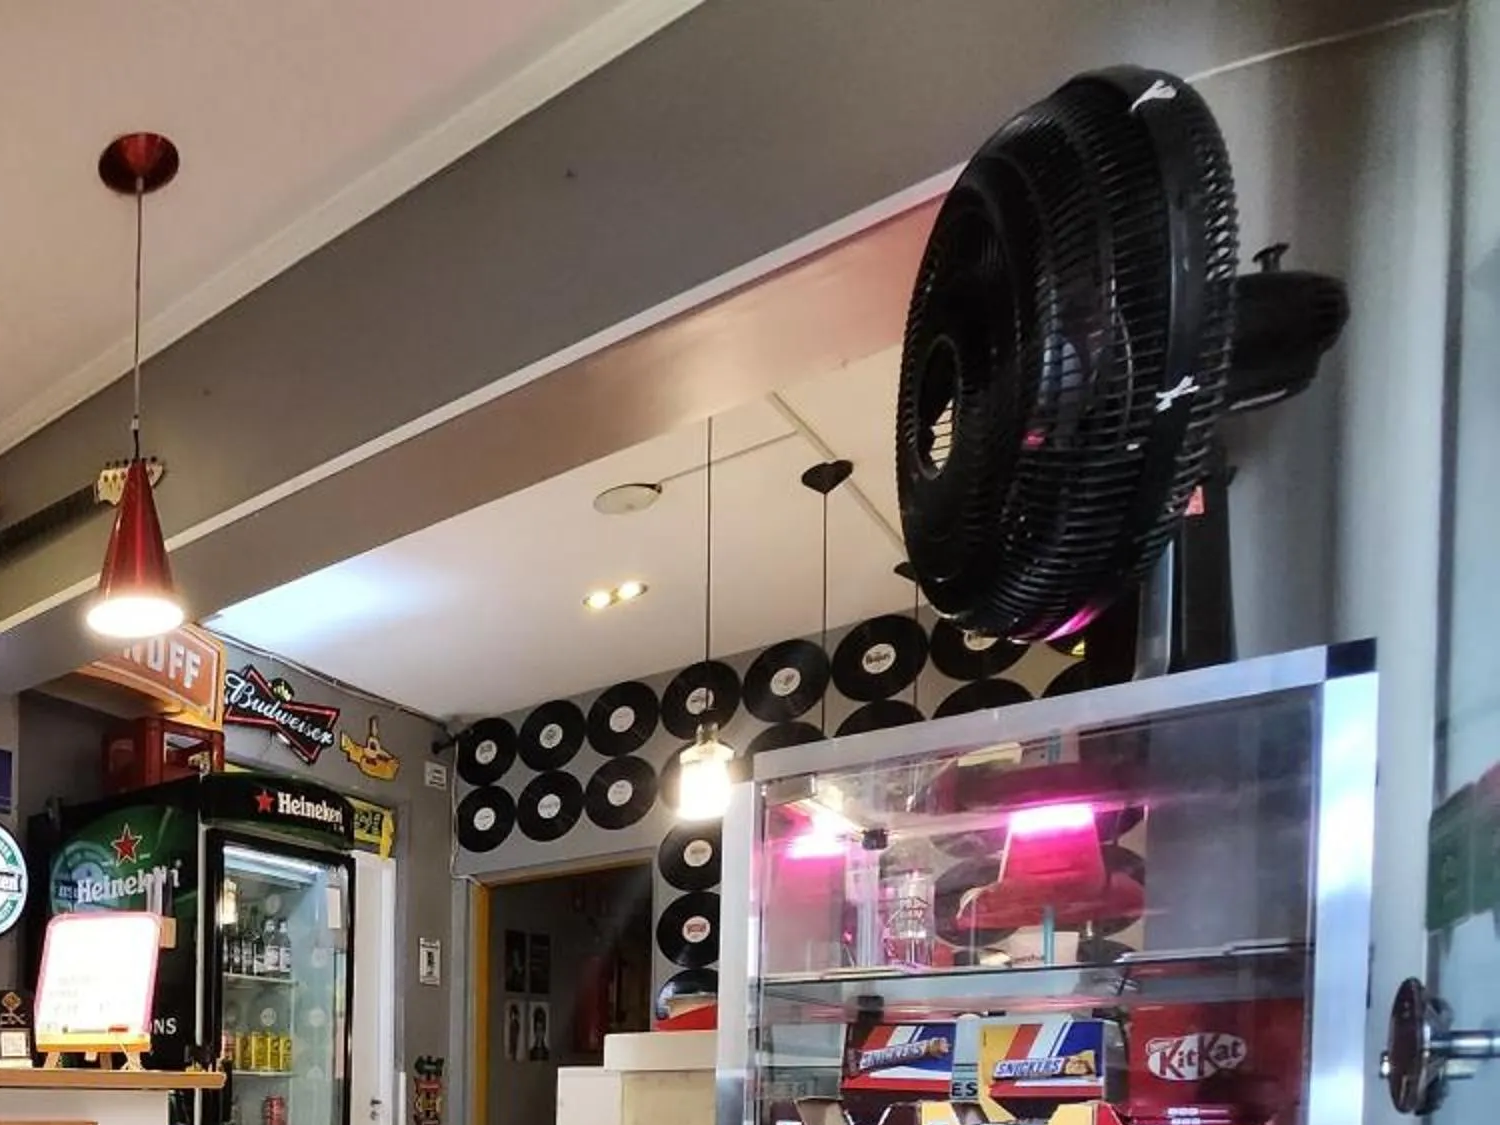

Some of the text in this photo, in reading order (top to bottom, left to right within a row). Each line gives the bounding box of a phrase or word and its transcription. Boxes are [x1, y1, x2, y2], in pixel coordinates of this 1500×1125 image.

[224, 672, 333, 745] Budweiser
[277, 791, 343, 823] Heineken
[995, 1058, 1062, 1078] SNICKERS
